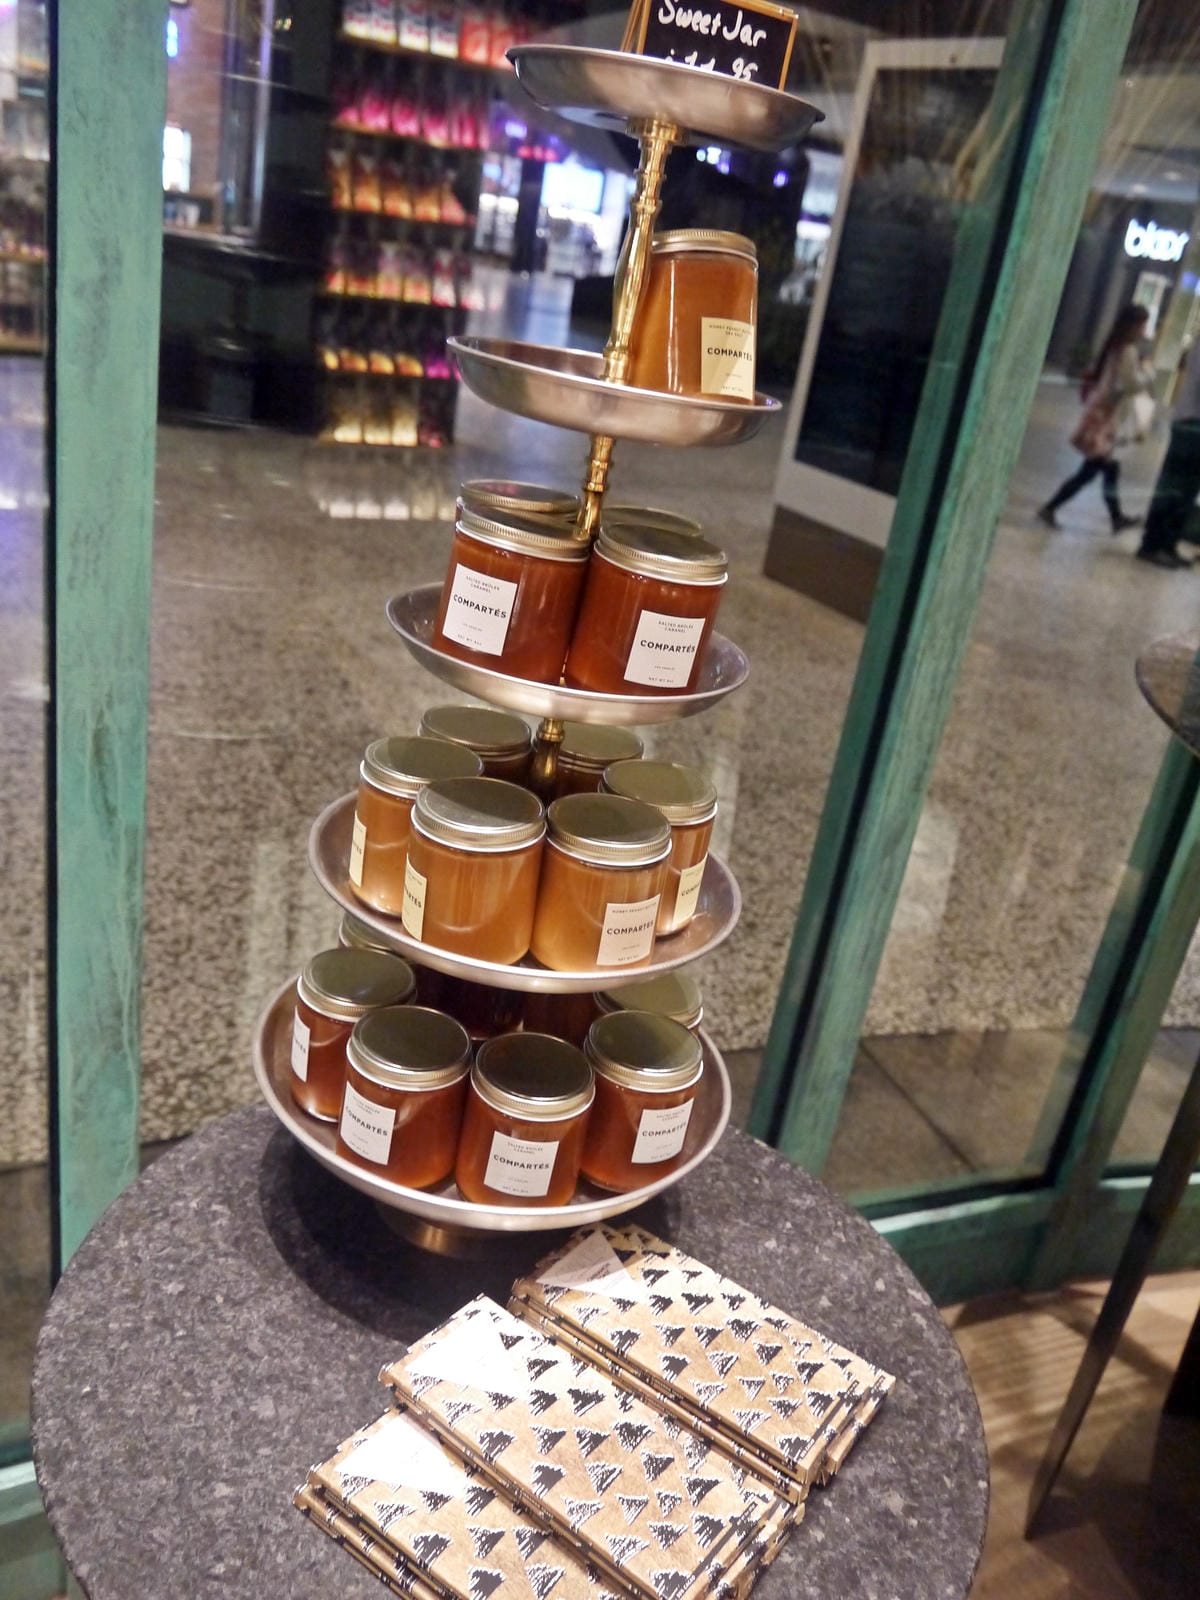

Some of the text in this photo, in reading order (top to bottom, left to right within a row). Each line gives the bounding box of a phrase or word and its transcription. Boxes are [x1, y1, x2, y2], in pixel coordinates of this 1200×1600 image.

[658, 0, 767, 47] Sweet Jar
[454, 594, 507, 618] COMPARTÉS
[640, 639, 696, 653] COMPARTÉS
[493, 1153, 550, 1170] COMPARTÉS
